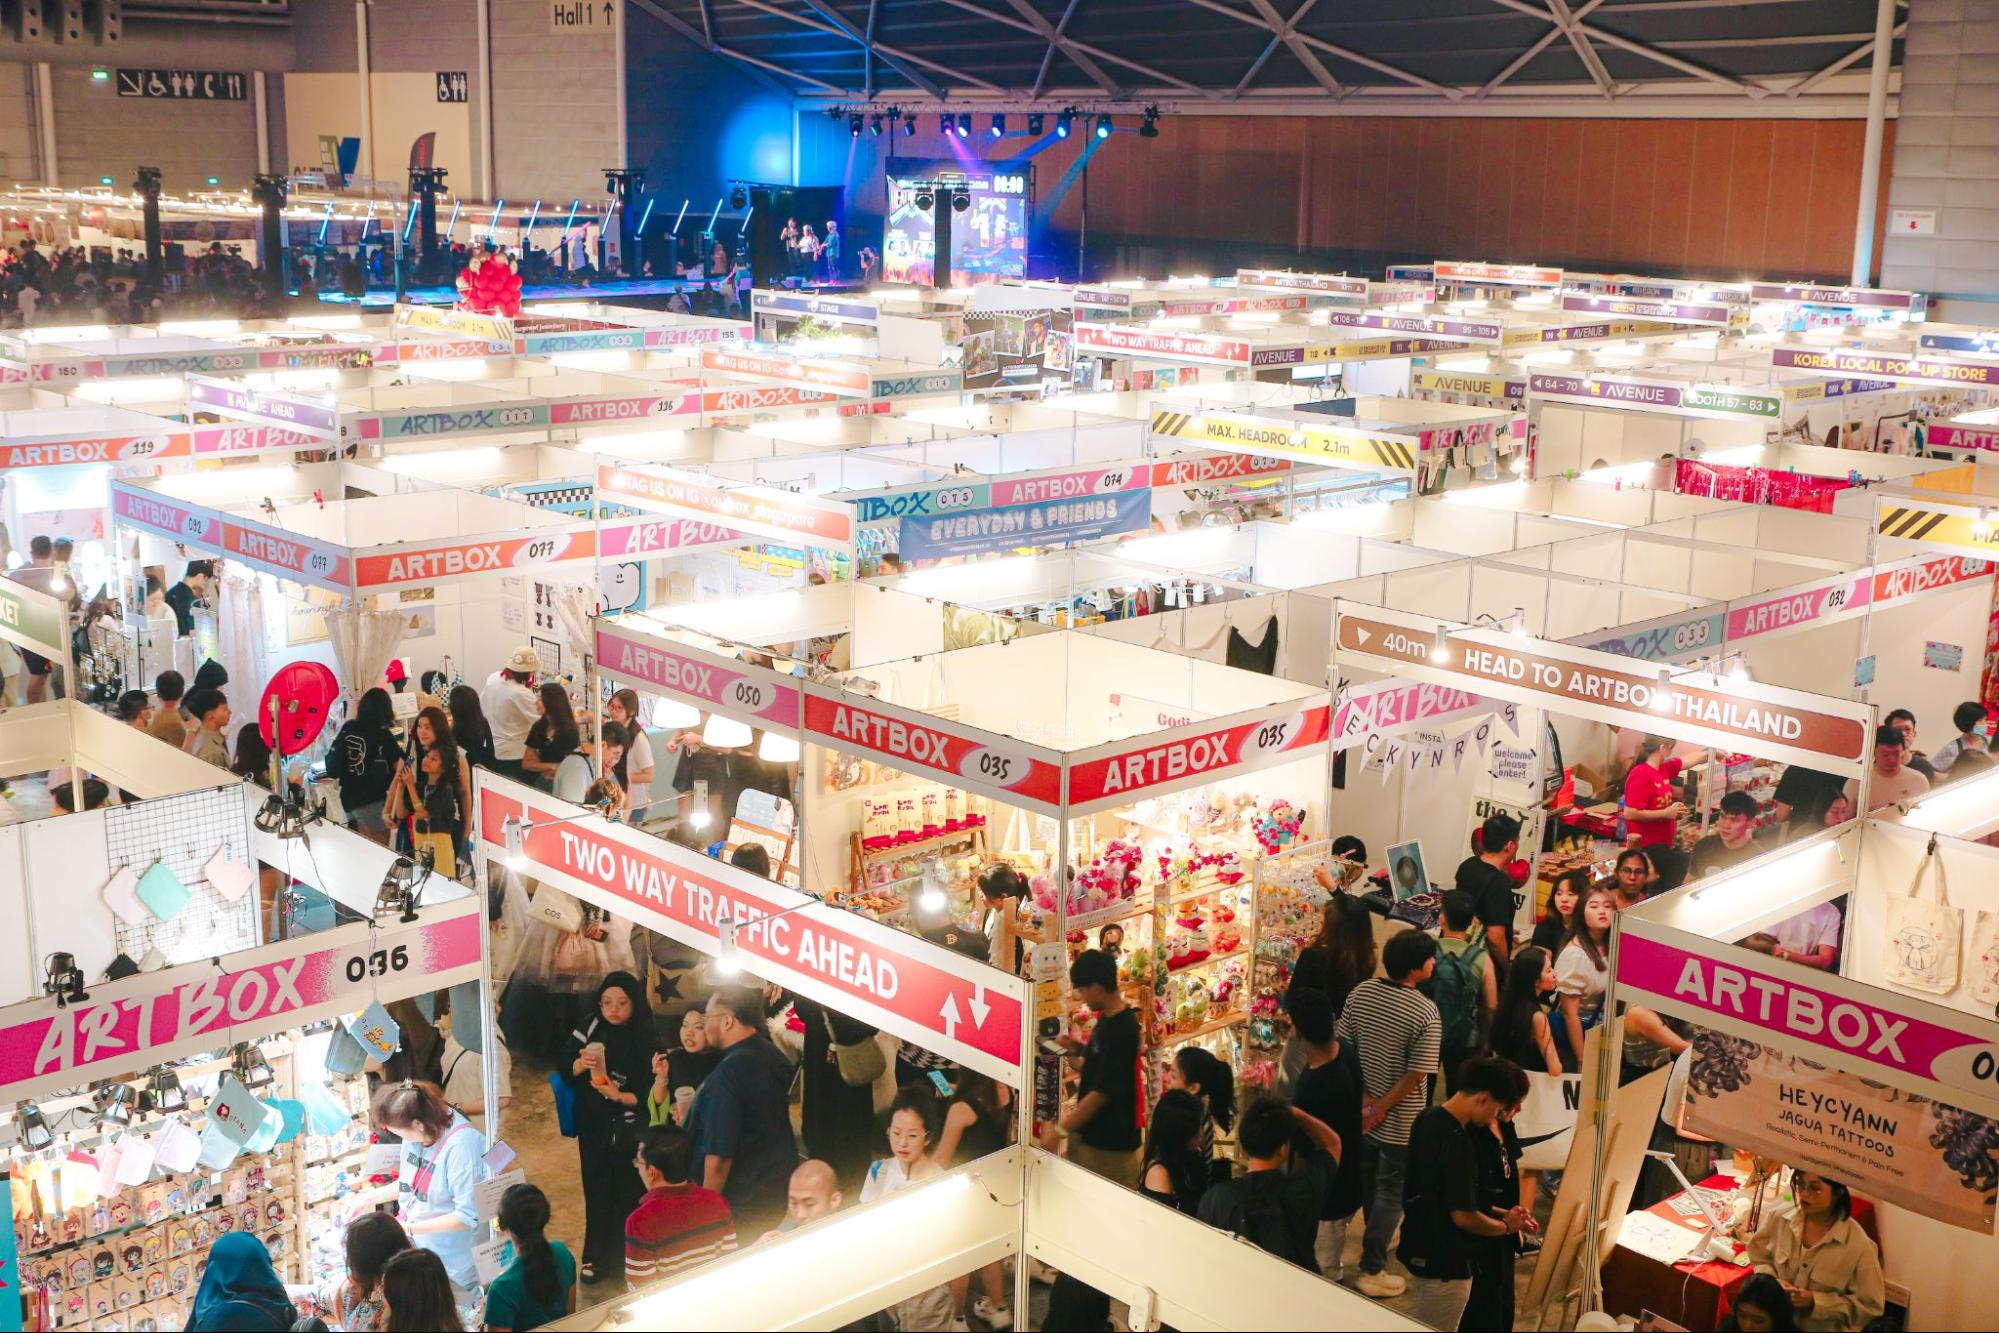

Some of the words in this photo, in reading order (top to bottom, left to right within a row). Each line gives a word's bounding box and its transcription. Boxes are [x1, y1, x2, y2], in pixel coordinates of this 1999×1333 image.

[554, 2, 583, 26] Hall
[586, 4, 593, 25] 1
[1812, 291, 1858, 303] AVENUE
[820, 303, 838, 314] STAGE
[657, 328, 713, 345] ARTBOX
[1392, 320, 1433, 331] AVENUE
[1572, 326, 1604, 337] AVENUE
[412, 342, 482, 359] ARTBOX
[539, 335, 607, 352] ARTBOX
[1106, 334, 1127, 346] TWO
[1128, 336, 1148, 348] WAY
[1149, 338, 1184, 352] TRAFFIC
[1185, 341, 1216, 354] AHEAD
[124, 356, 208, 374] ARTBOX
[738, 360, 748, 370] US
[1254, 350, 1296, 365] AVENUE
[1794, 353, 1837, 368] KOREA
[1839, 356, 1883, 373] LOCAL
[1887, 360, 1941, 377] POP-UP
[1943, 364, 1988, 381] STORE
[1435, 377, 1491, 394] AVENUE
[1545, 380, 1557, 390] 64
[1566, 382, 1578, 392] 70
[1606, 385, 1665, 402] AVENUE
[271, 402, 295, 418] AHEAD
[717, 388, 793, 410] ARTBOX
[1727, 398, 1740, 408] 57
[1749, 400, 1763, 411] 63
[570, 400, 640, 421] ARTBOX
[658, 400, 673, 412] 116
[400, 410, 494, 435] ARTBOX
[505, 411, 528, 423] 117
[1207, 424, 1235, 439] MAX.
[1239, 429, 1307, 449] HEADROOM
[1323, 439, 1350, 455] 2.1m
[9, 442, 110, 465] ARTBOX
[133, 441, 155, 455] 119
[1166, 455, 1246, 482] ARTBOX
[625, 476, 648, 493] TAG
[651, 479, 665, 496] US
[668, 482, 684, 499] ON
[686, 486, 700, 502] IG
[1011, 475, 1086, 503] ARTBOX
[1104, 473, 1122, 487] 074
[940, 494, 970, 506] 075
[127, 495, 177, 529] ARTBOX
[930, 512, 1025, 540] EVERYDAY
[1030, 508, 1042, 529] &
[1047, 499, 1117, 526] FRIENDS
[239, 530, 299, 568] ARTBOX
[312, 554, 327, 572] 077
[387, 544, 504, 581] ARTBOX
[530, 541, 555, 559] 077
[1885, 557, 1957, 596] ARTBOX
[1744, 594, 1815, 635] ARTBOX
[1829, 589, 1845, 608] 032
[1677, 628, 1706, 643] 033
[620, 643, 713, 697] ARTBOX
[736, 682, 761, 706] 050
[1383, 633, 1426, 658] 40m
[1464, 648, 1525, 680] HEAD
[1531, 662, 1562, 687] TO
[1671, 692, 1802, 741] THAILAND
[832, 705, 950, 768] ARTBOX
[980, 752, 1011, 780] 035
[1420, 732, 1441, 744] INSTA
[1102, 733, 1230, 793] ARTBOX
[1259, 723, 1287, 748] 035
[1495, 749, 1533, 761] welcome
[1498, 759, 1528, 770] please
[1498, 769, 1526, 779] enter!
[544, 907, 561, 920] COS
[561, 830, 618, 880] TWO
[623, 854, 680, 908] WAY
[684, 880, 792, 956] TRAFFIC
[799, 928, 900, 1000] AHEAD
[34, 957, 307, 1077] ARTBOX
[347, 945, 409, 983] 036
[1674, 959, 1909, 1064] ARTBOX
[1779, 1083, 1898, 1137] HEYCYANN
[1779, 1111, 1823, 1134] JAGUA
[1829, 1123, 1895, 1158] TATTOOS
[1868, 1158, 1885, 1172] Pain
[1886, 1166, 1904, 1177] Free
